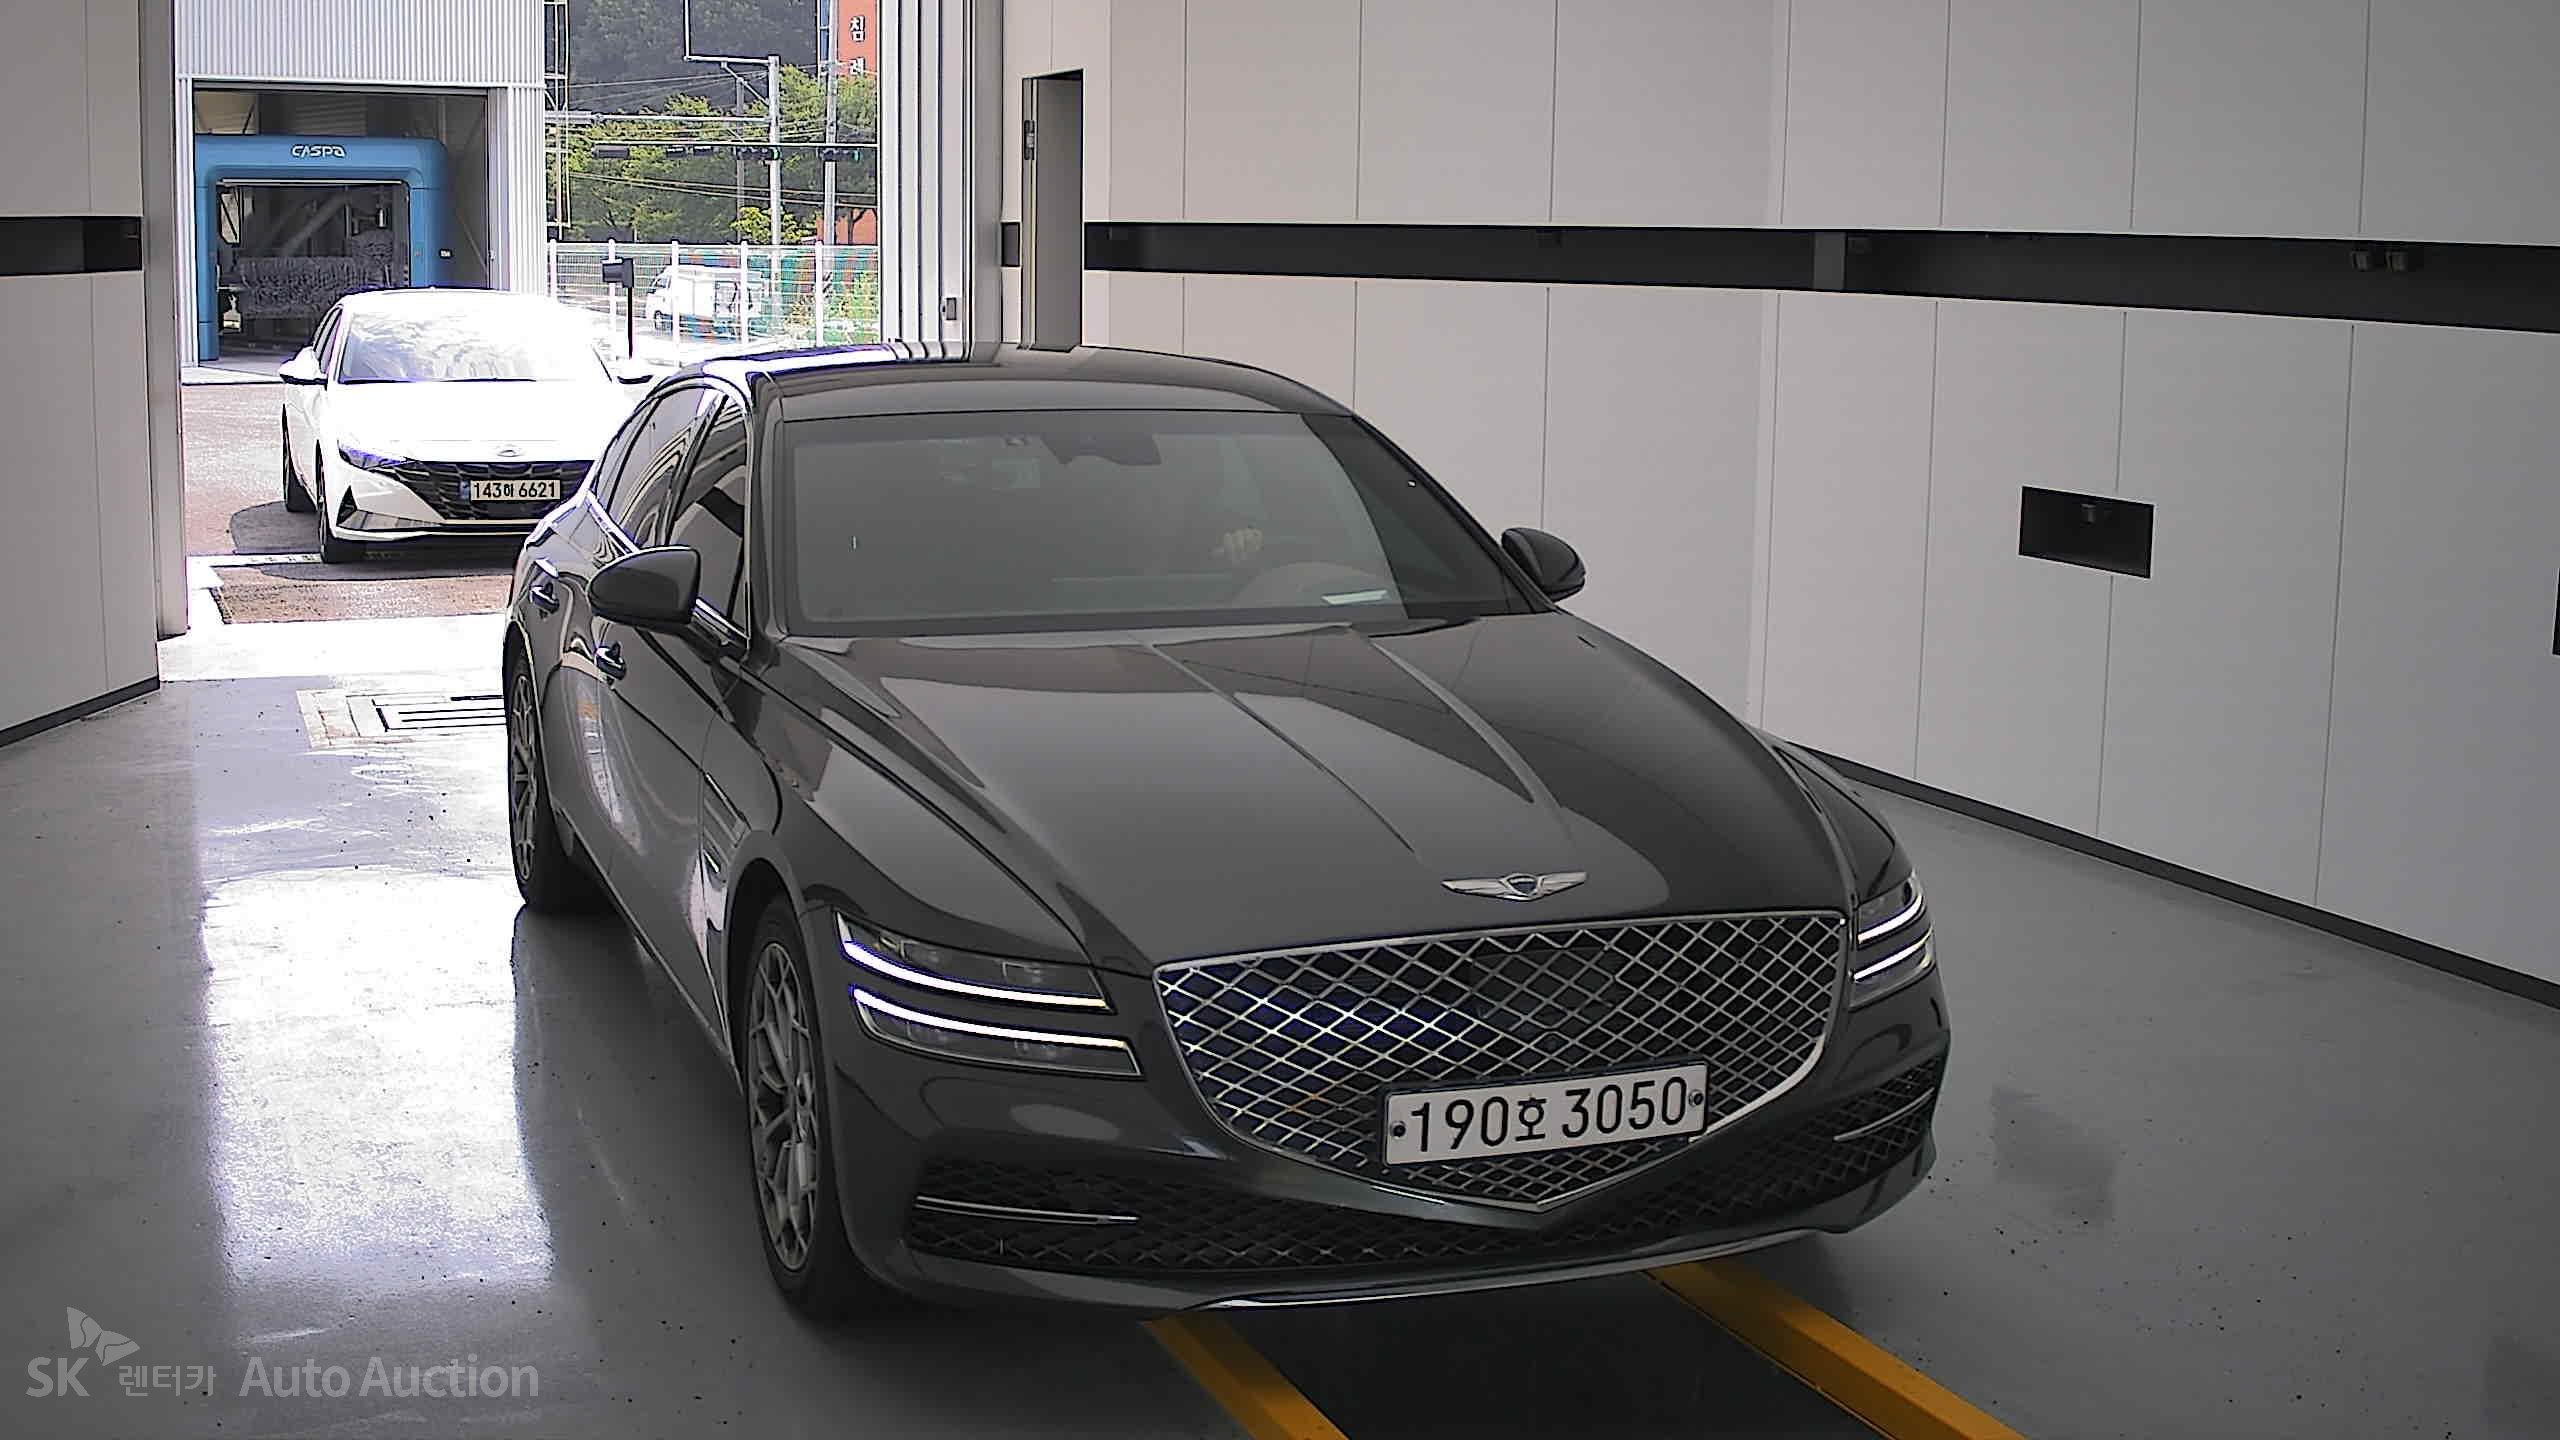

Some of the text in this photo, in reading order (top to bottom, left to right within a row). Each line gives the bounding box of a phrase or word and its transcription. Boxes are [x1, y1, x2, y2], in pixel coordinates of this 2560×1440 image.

[518, 482, 555, 498] 6621
[1410, 1076, 1688, 1153] 190호 3050
